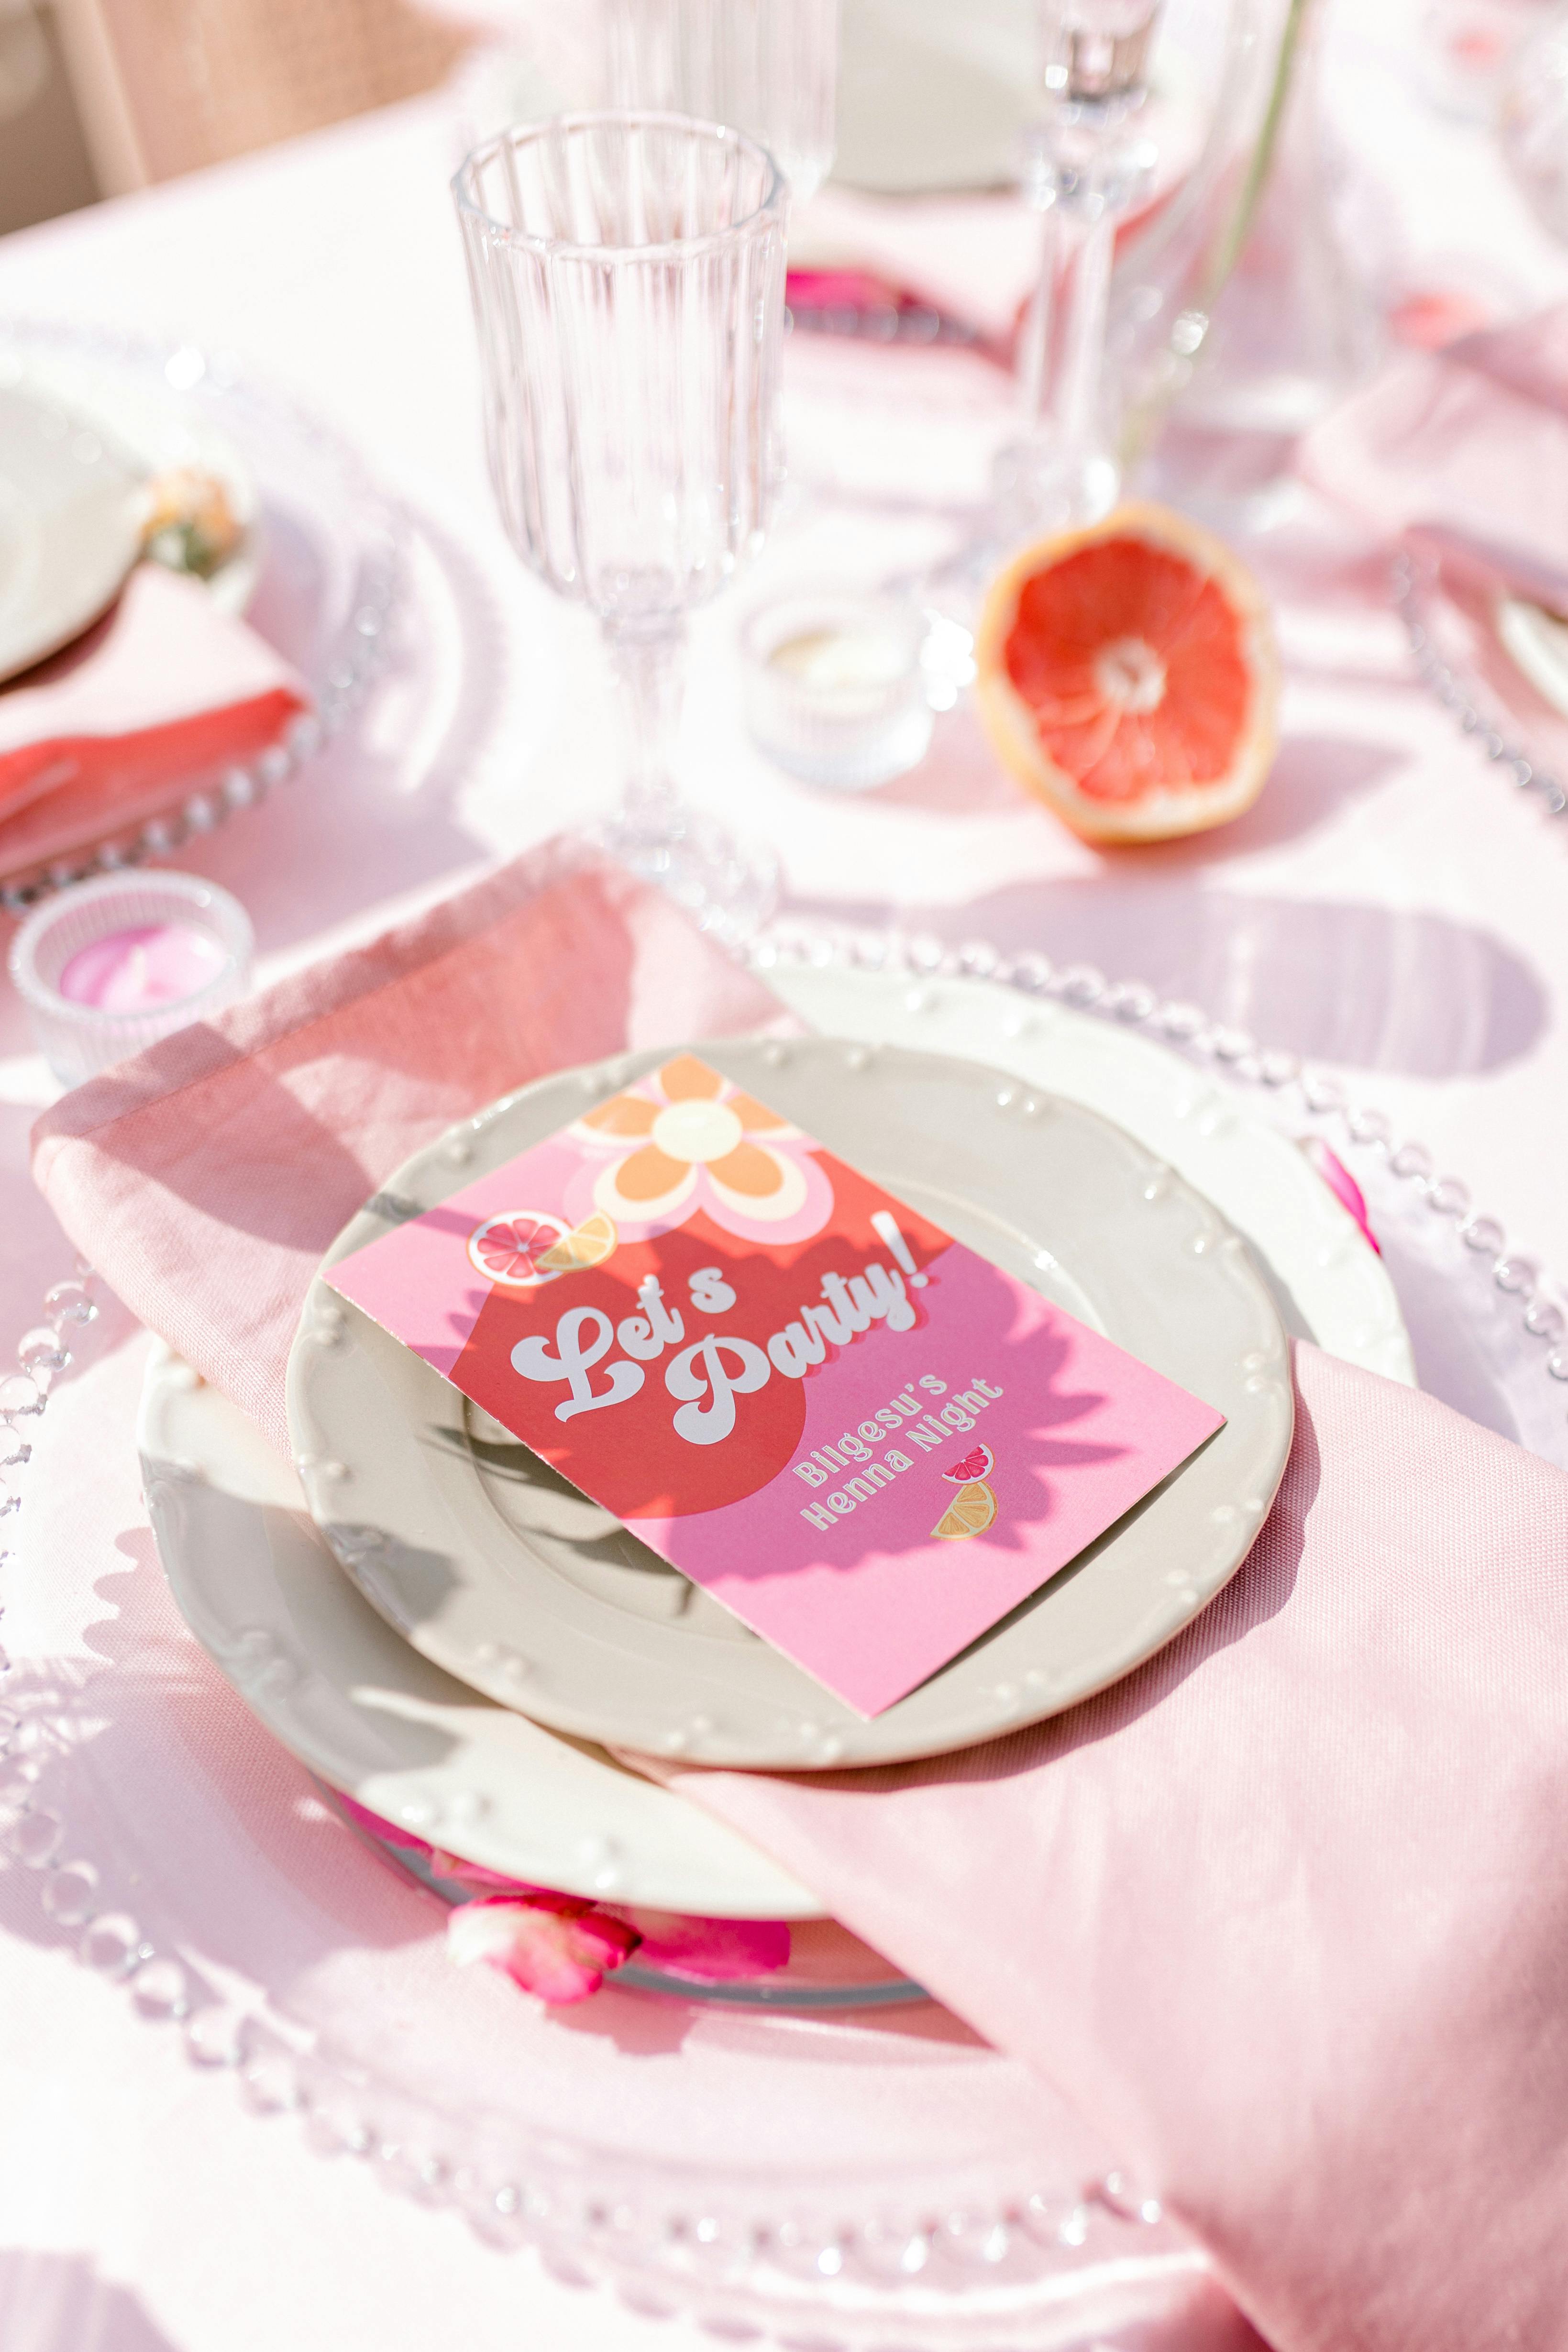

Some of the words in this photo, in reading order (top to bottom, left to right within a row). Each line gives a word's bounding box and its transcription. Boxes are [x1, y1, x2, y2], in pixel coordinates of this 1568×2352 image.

[511, 1266, 737, 1423] Let's
[664, 1210, 929, 1445] Party!
[792, 1374, 948, 1488] Bilgesu's
[800, 1449, 914, 1531] Henna
[905, 1378, 1004, 1453] Night
